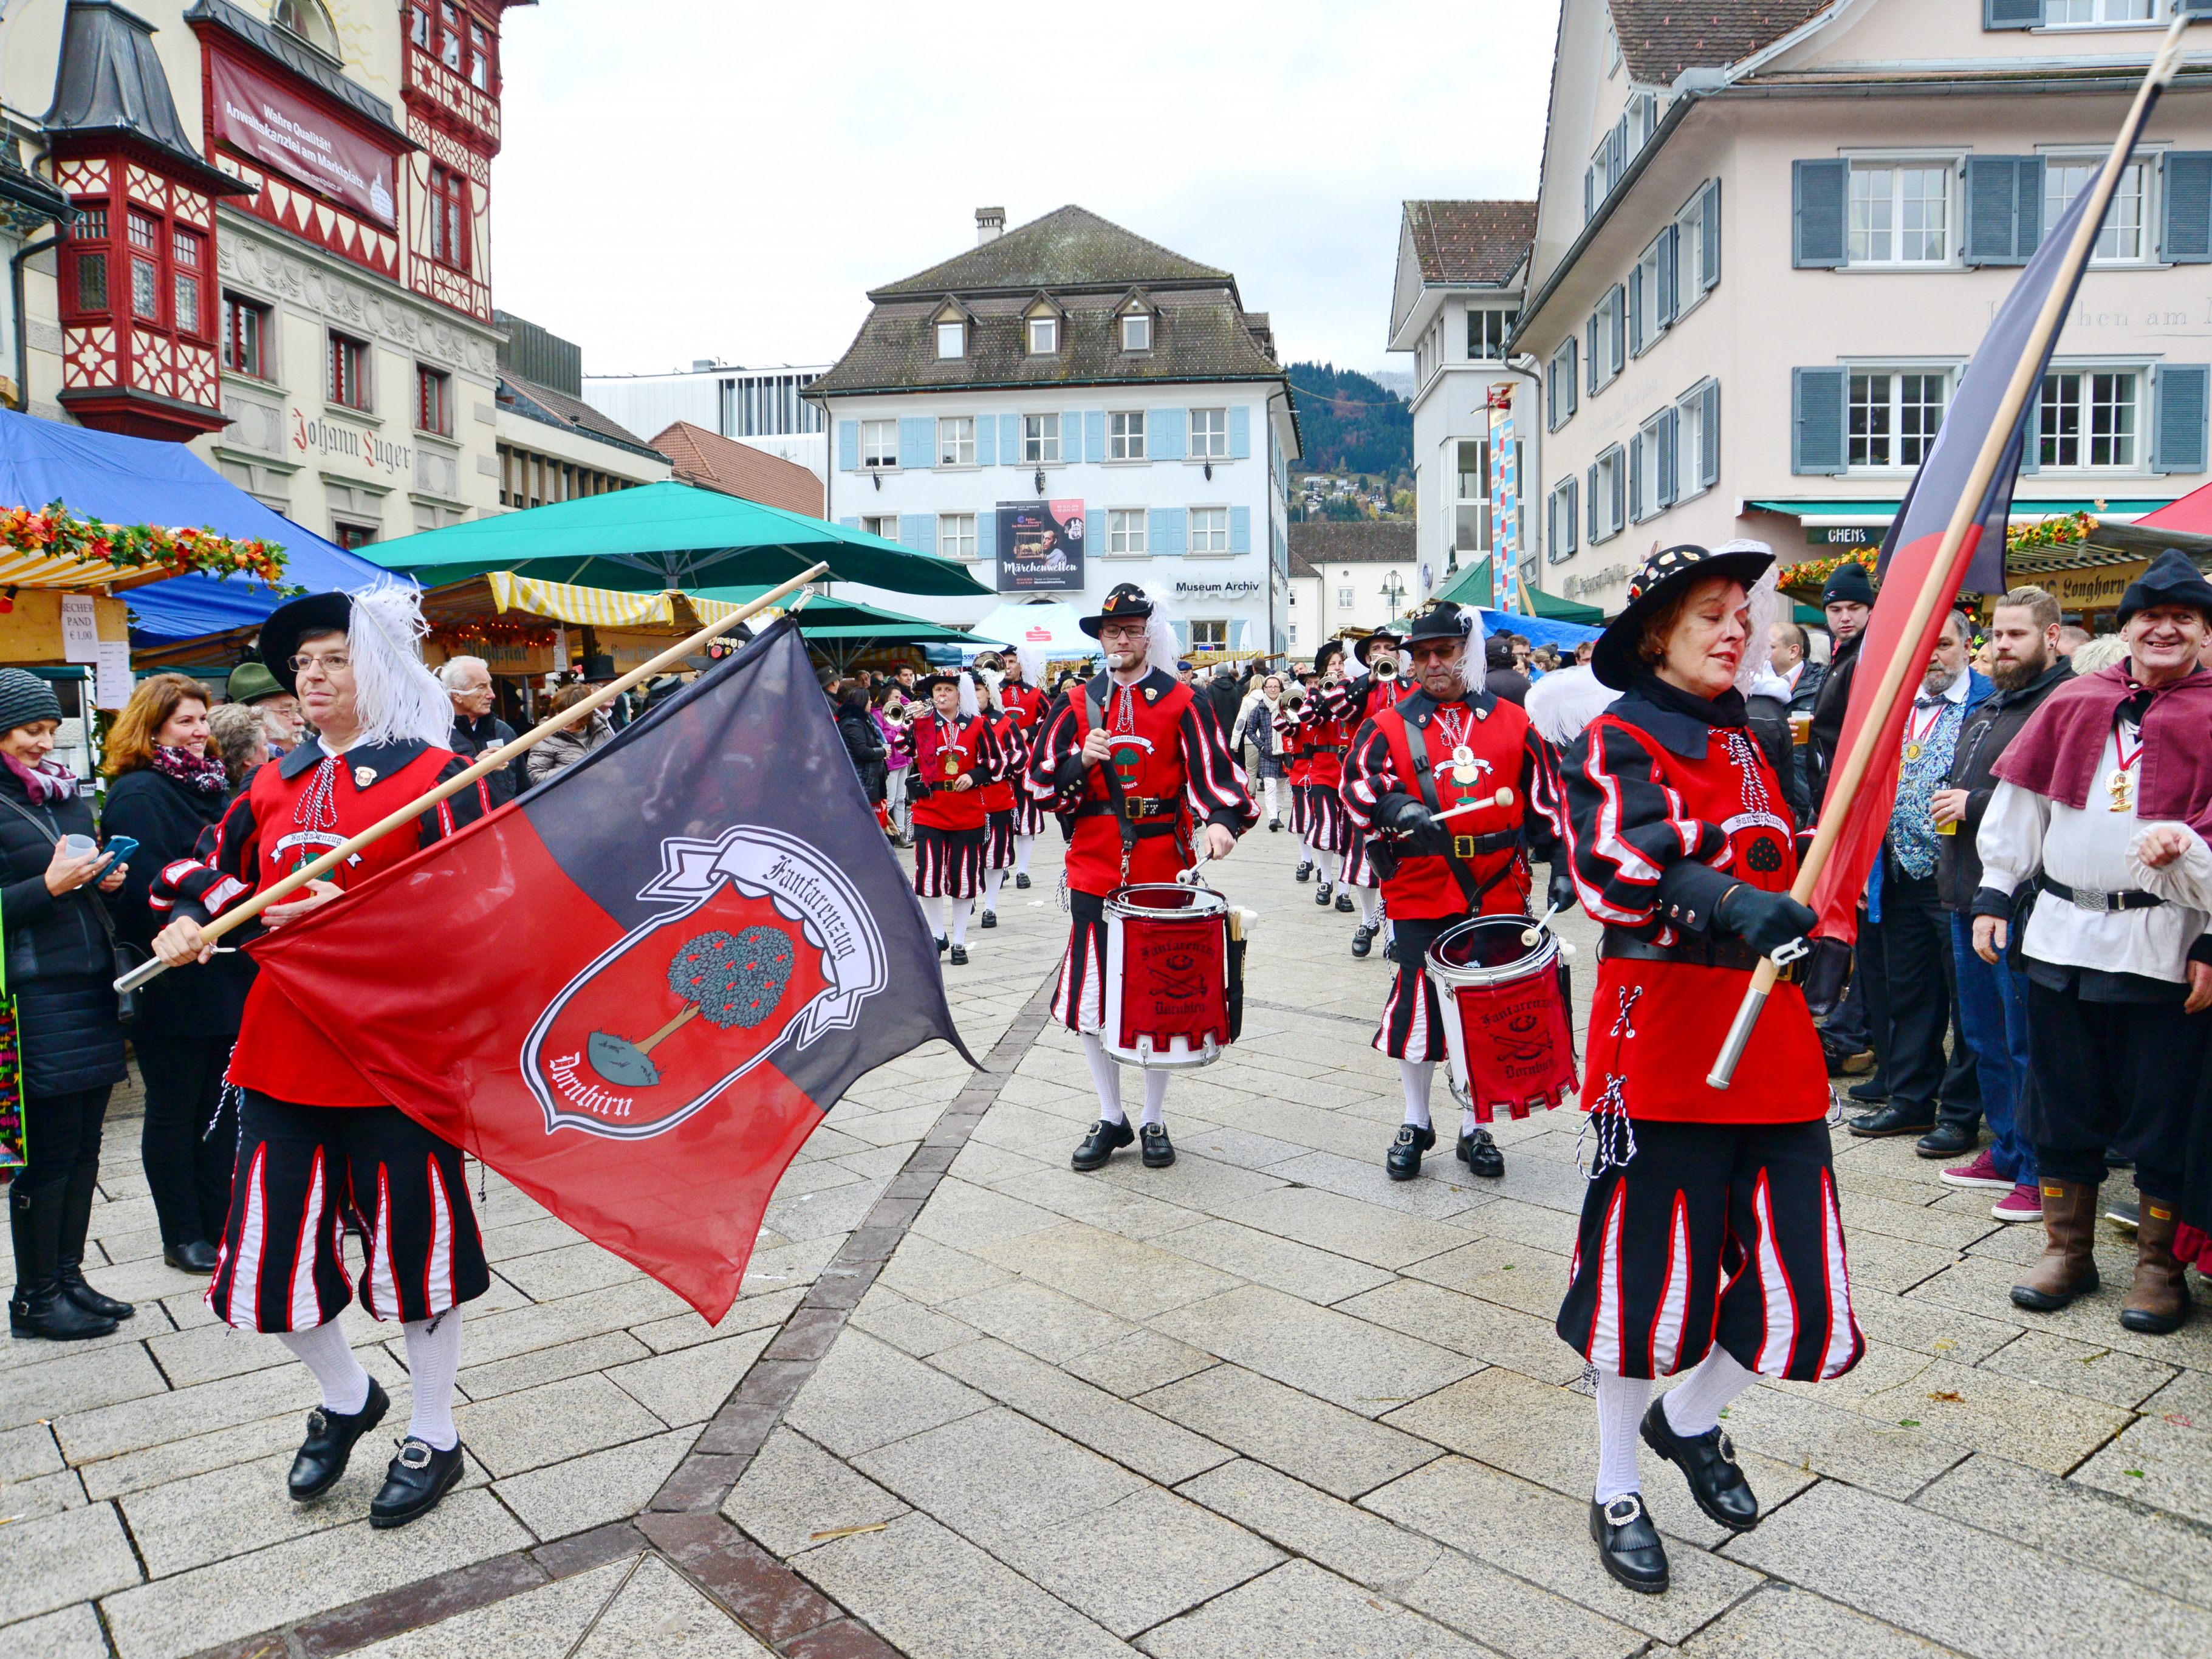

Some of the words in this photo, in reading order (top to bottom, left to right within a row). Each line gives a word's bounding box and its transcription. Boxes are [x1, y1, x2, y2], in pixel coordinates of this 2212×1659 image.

[226, 101, 301, 154] Anwaltskanzlei
[301, 145, 317, 162] am
[317, 152, 365, 190] Marktplatz
[264, 104, 293, 131] Wahre
[293, 123, 332, 152] Qualität!
[292, 408, 359, 457] Johann
[363, 429, 411, 474] Luger
[1828, 528, 1866, 542] CHEN's
[1003, 561, 1078, 576] Märchenwelten
[1176, 582, 1222, 592] Museum
[1225, 581, 1259, 591] Archiv
[67, 617, 92, 626] PAND
[762, 854, 856, 961] Fanfarenzug
[549, 1051, 633, 1117] Dornbirn
